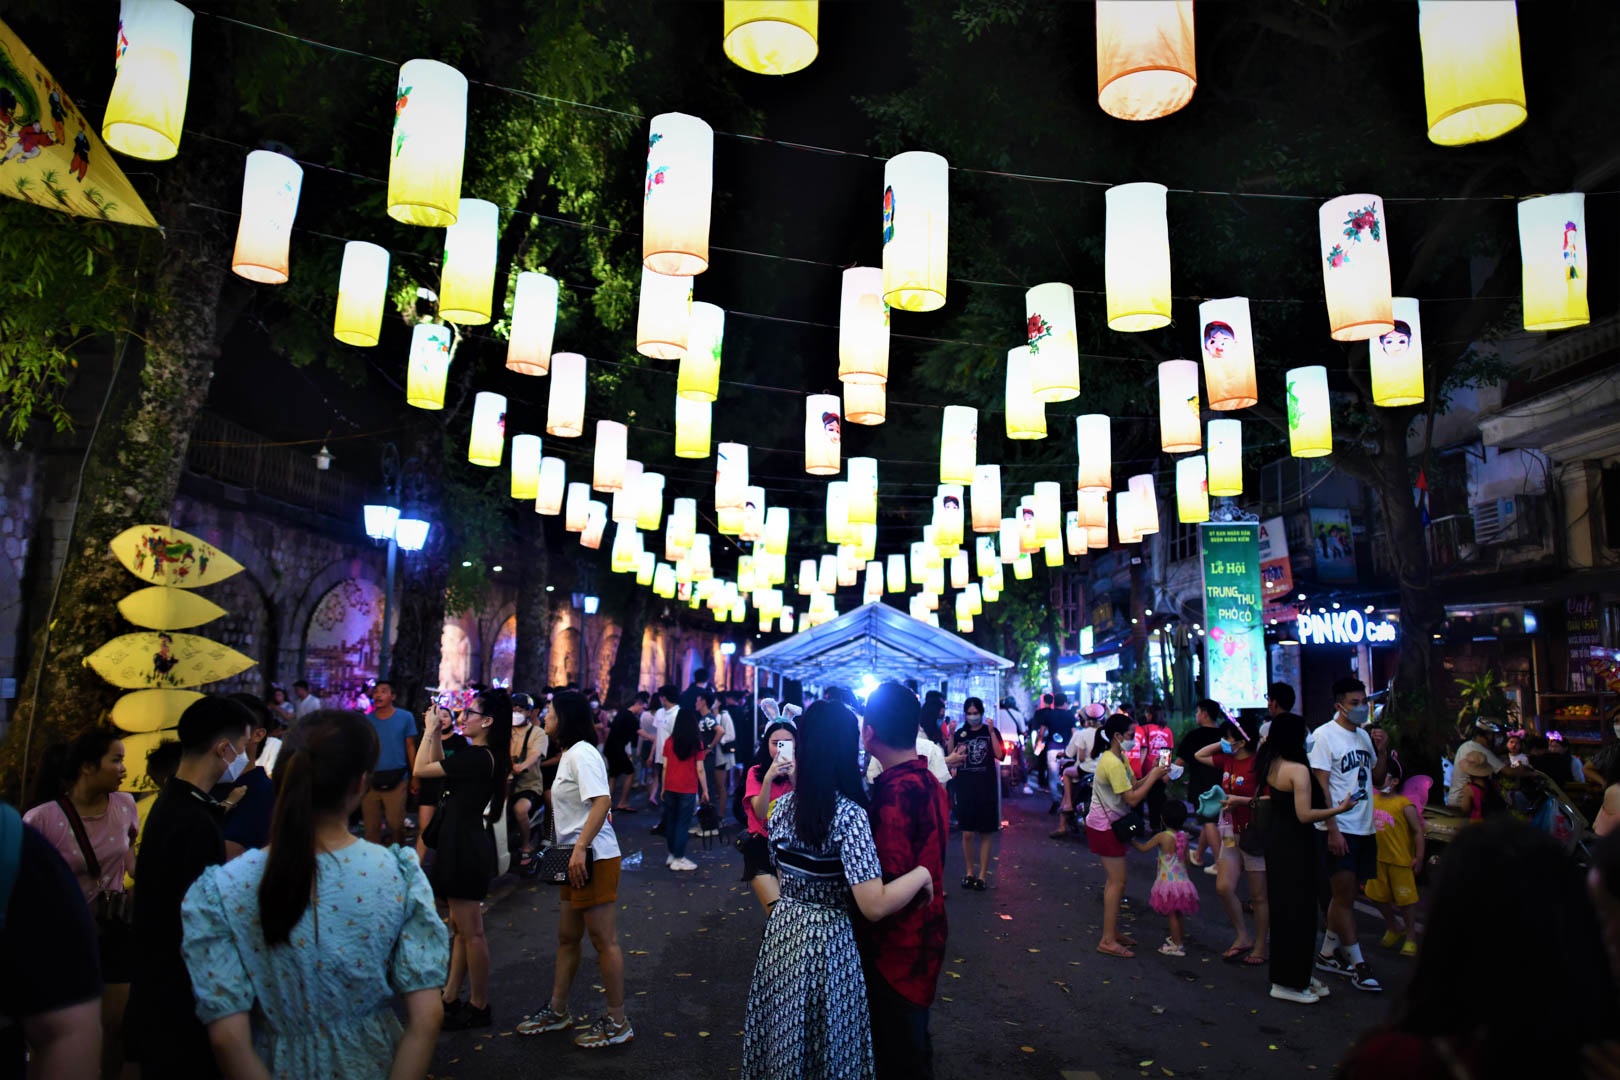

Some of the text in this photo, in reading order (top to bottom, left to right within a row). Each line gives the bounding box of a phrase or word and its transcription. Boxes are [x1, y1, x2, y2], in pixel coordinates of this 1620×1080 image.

[1226, 562, 1246, 576] Hội
[1207, 586, 1255, 605] TRUNG THU
[1297, 610, 1364, 644] PINKO
